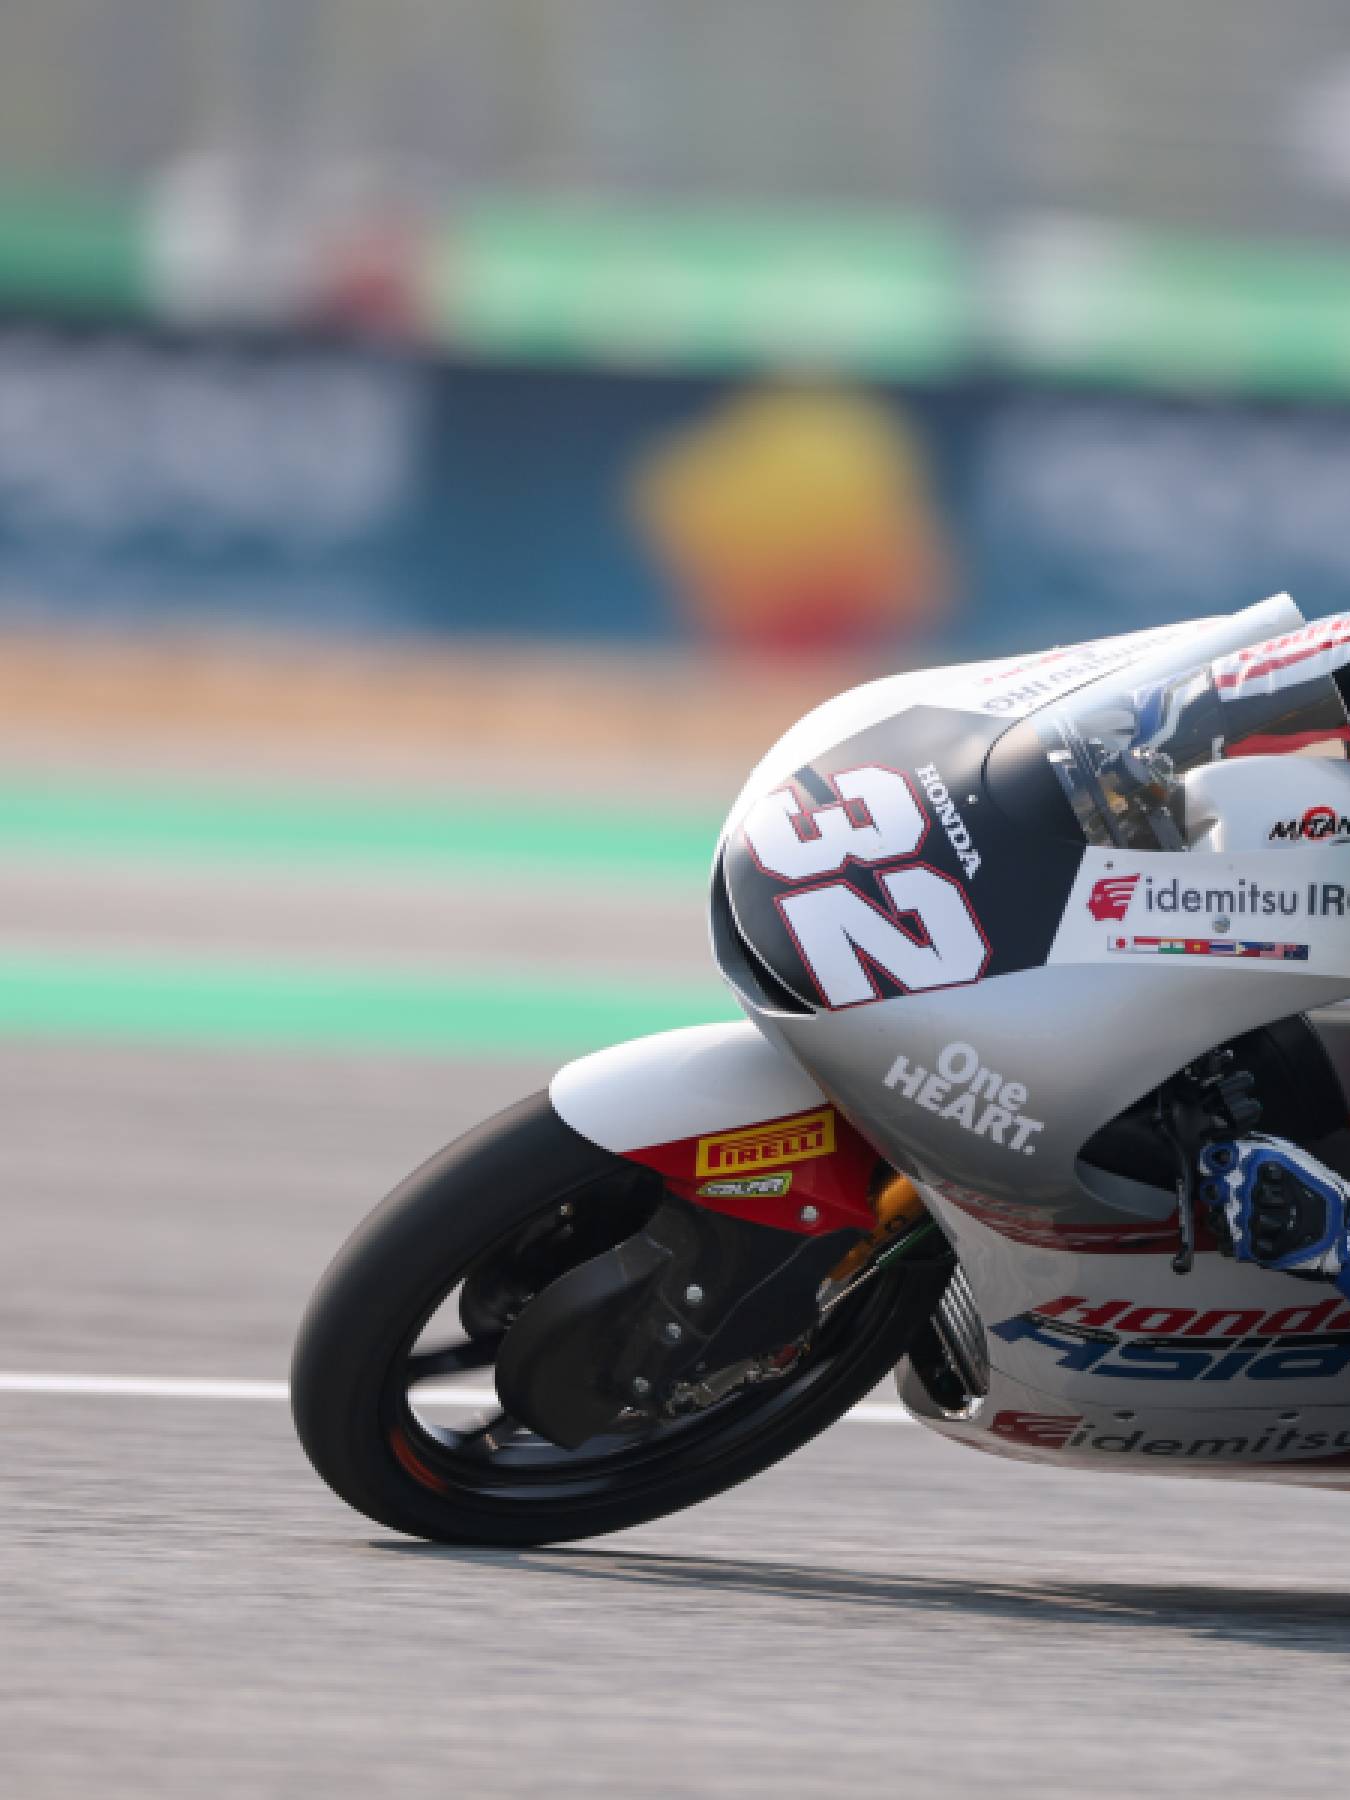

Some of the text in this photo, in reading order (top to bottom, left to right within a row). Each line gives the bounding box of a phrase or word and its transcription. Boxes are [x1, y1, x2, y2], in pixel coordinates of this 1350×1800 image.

[913, 762, 983, 880] HONDA
[742, 762, 993, 1012] 32
[1146, 878, 1298, 915] idemitsu
[882, 1055, 1045, 1156] HEART.
[937, 1041, 1029, 1112] One
[707, 1121, 826, 1169] PIRELLI
